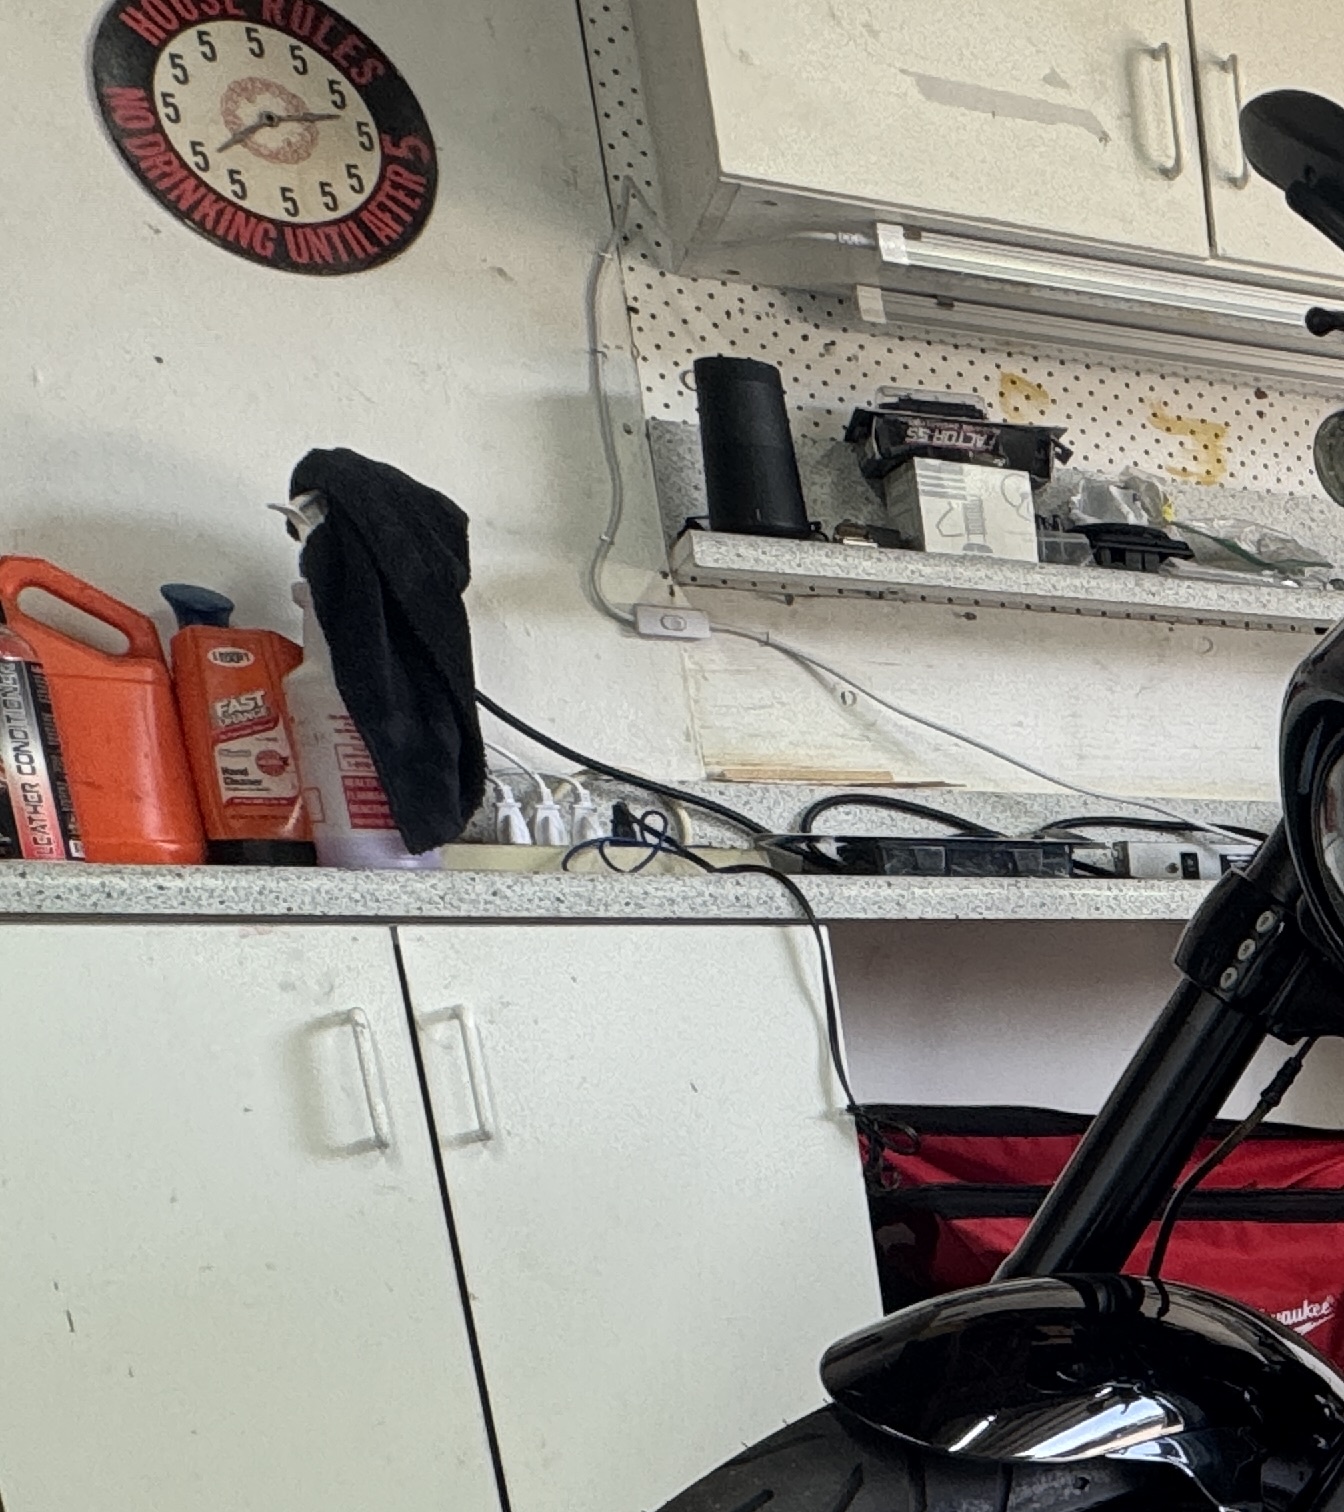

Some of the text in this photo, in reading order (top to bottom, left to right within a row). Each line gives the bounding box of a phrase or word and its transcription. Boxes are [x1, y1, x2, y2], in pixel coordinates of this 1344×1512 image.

[197, 30, 217, 62] 5
[245, 26, 265, 58] 5
[262, 0, 386, 86] RULES
[168, 52, 190, 85] 5
[289, 44, 308, 75] 5
[161, 91, 181, 123] 5
[327, 78, 346, 110] 5
[356, 120, 375, 151] 5
[189, 140, 210, 173] 5
[104, 86, 431, 265] NO DRINKING UNTIL AFTER 5
[228, 168, 248, 200] 5
[345, 163, 364, 194] 5
[280, 186, 299, 218] 5
[319, 181, 339, 212] 5
[214, 689, 266, 716] FAST
[1, 663, 54, 857] LEATHER CONDITIONER
